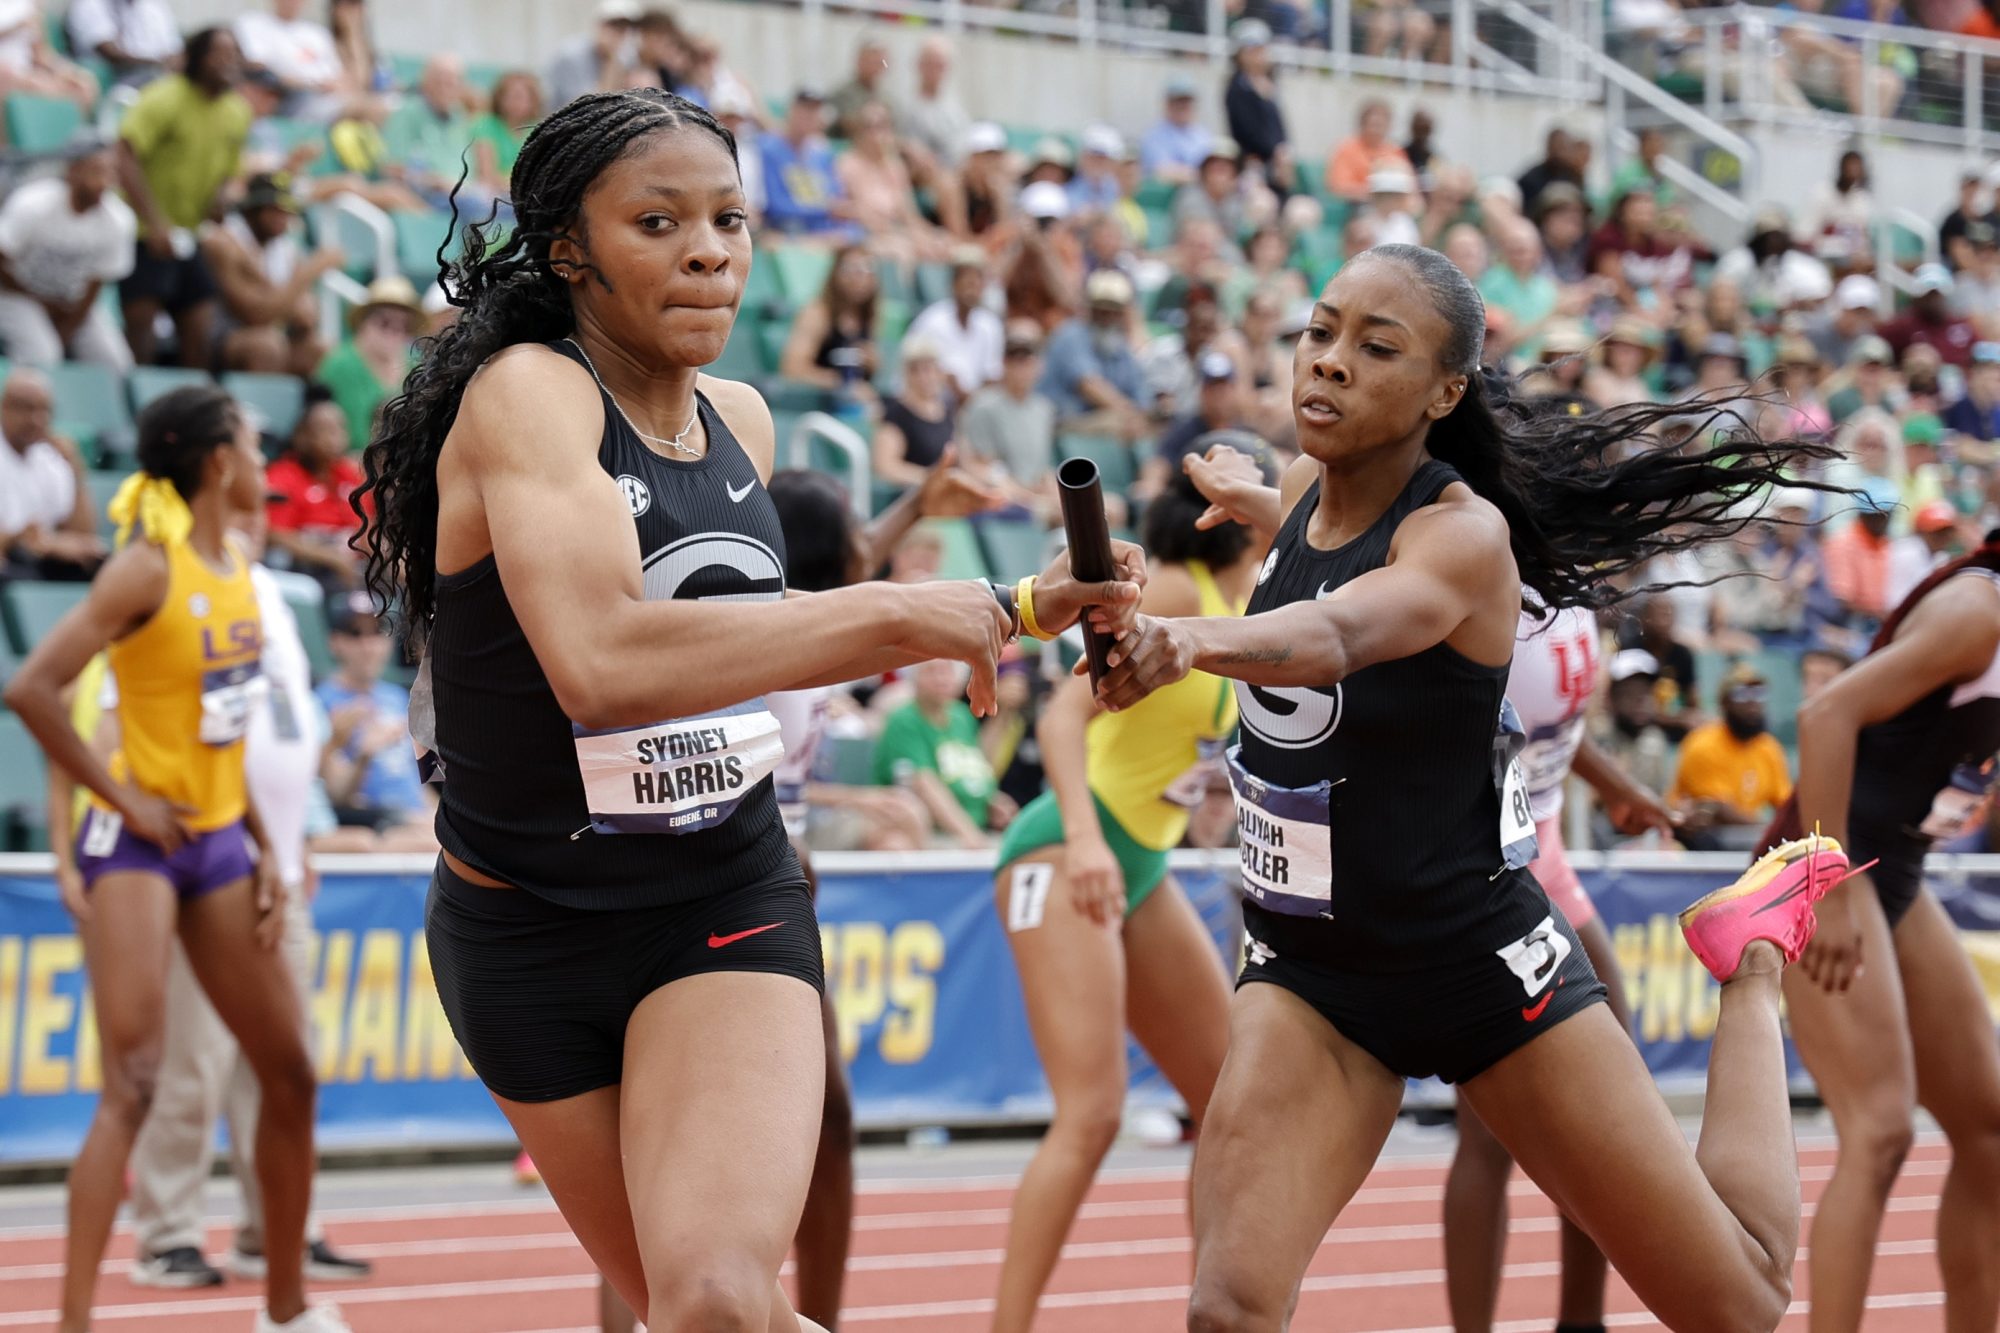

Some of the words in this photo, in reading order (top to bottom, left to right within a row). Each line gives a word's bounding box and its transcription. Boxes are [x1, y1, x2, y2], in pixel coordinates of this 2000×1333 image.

[637, 727, 728, 765] SYDNEY
[632, 755, 744, 804] HARRIS
[669, 810, 702, 827] EUGENE,
[704, 807, 718, 819] OR
[1236, 803, 1284, 848] ALIYAH
